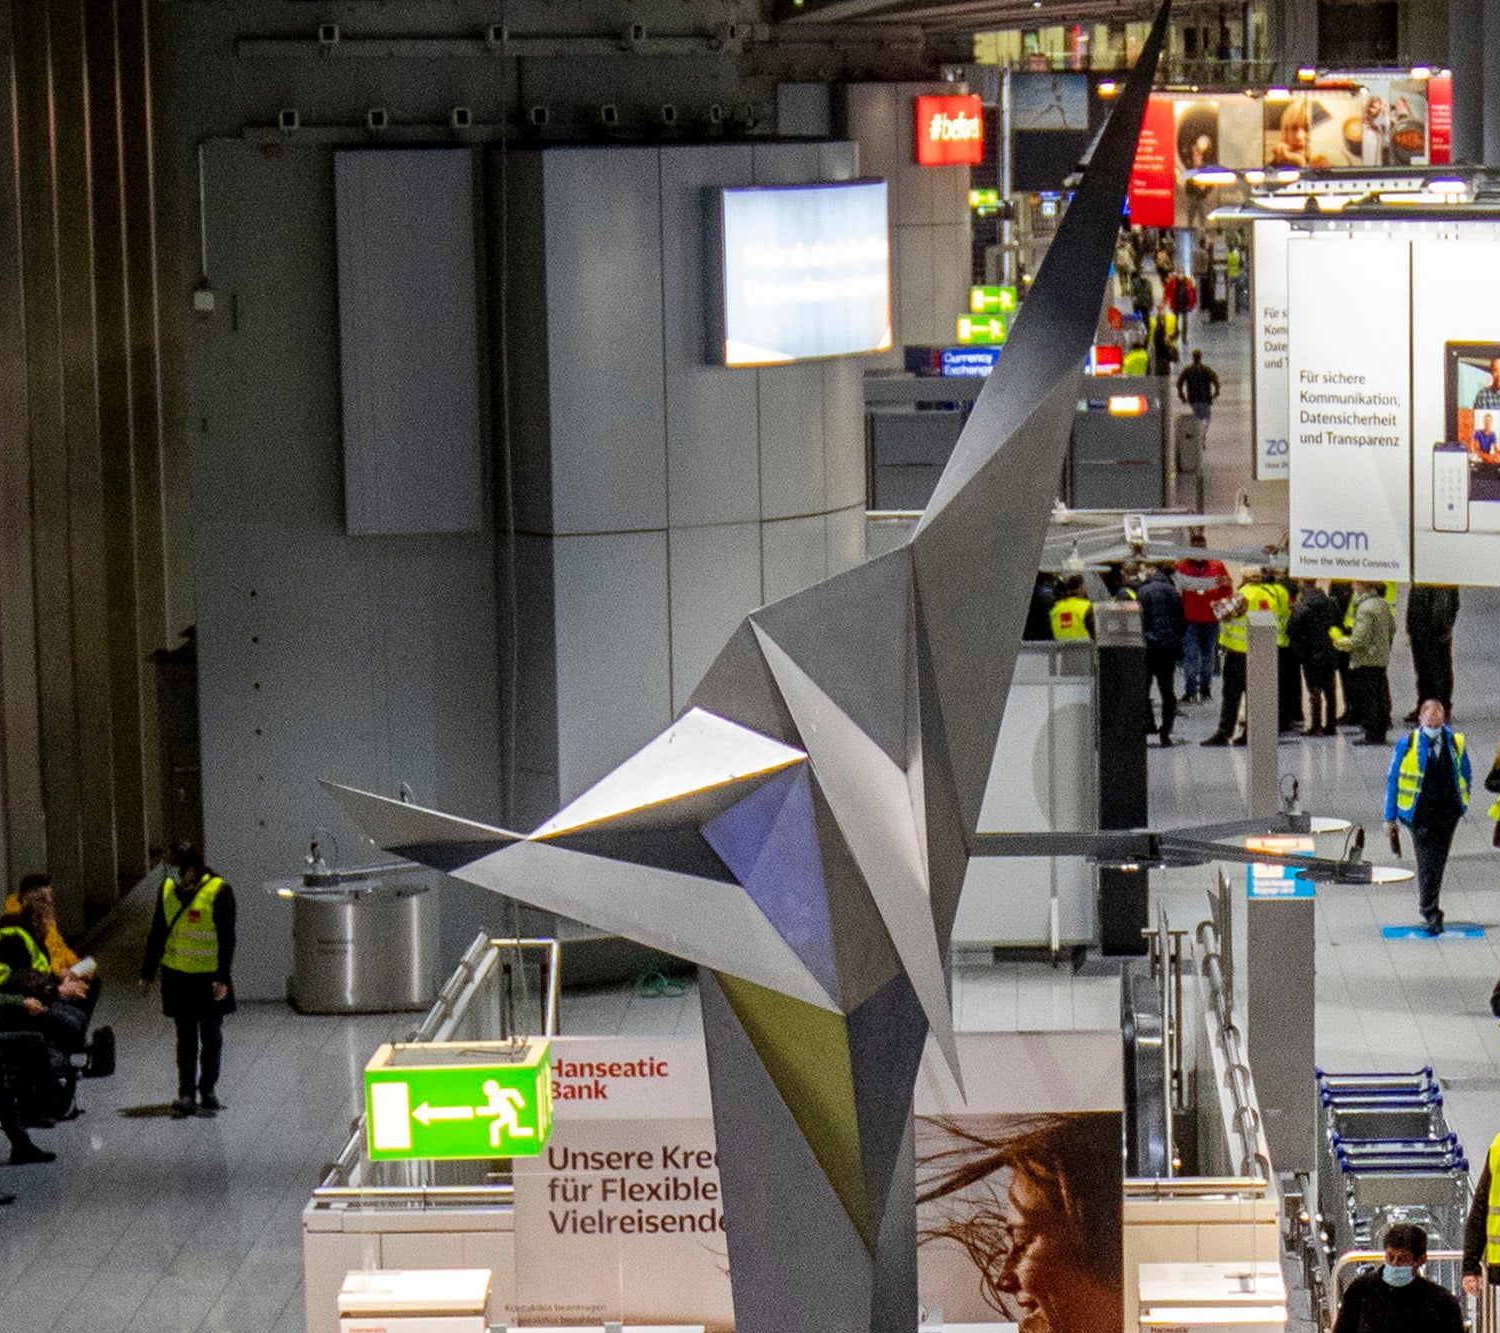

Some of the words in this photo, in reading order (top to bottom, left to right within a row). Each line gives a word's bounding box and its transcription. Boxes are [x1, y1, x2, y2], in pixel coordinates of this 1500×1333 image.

[1300, 370, 1321, 383] Für
[1322, 371, 1366, 384] sichere
[1300, 390, 1401, 407] Kommunikation,
[1300, 410, 1397, 427] Datensicherheit
[1266, 438, 1288, 456] zo
[1300, 431, 1323, 444] und
[1325, 431, 1400, 448] Transparenz
[1301, 529, 1369, 550] zoom
[1300, 555, 1318, 565] How
[1320, 556, 1333, 567] the
[1336, 557, 1361, 567] World
[550, 1057, 669, 1078] Hanseatic
[551, 1080, 608, 1100] Bank
[548, 1146, 654, 1170] Unsere
[548, 1177, 592, 1202] für
[602, 1177, 718, 1202] Flexible
